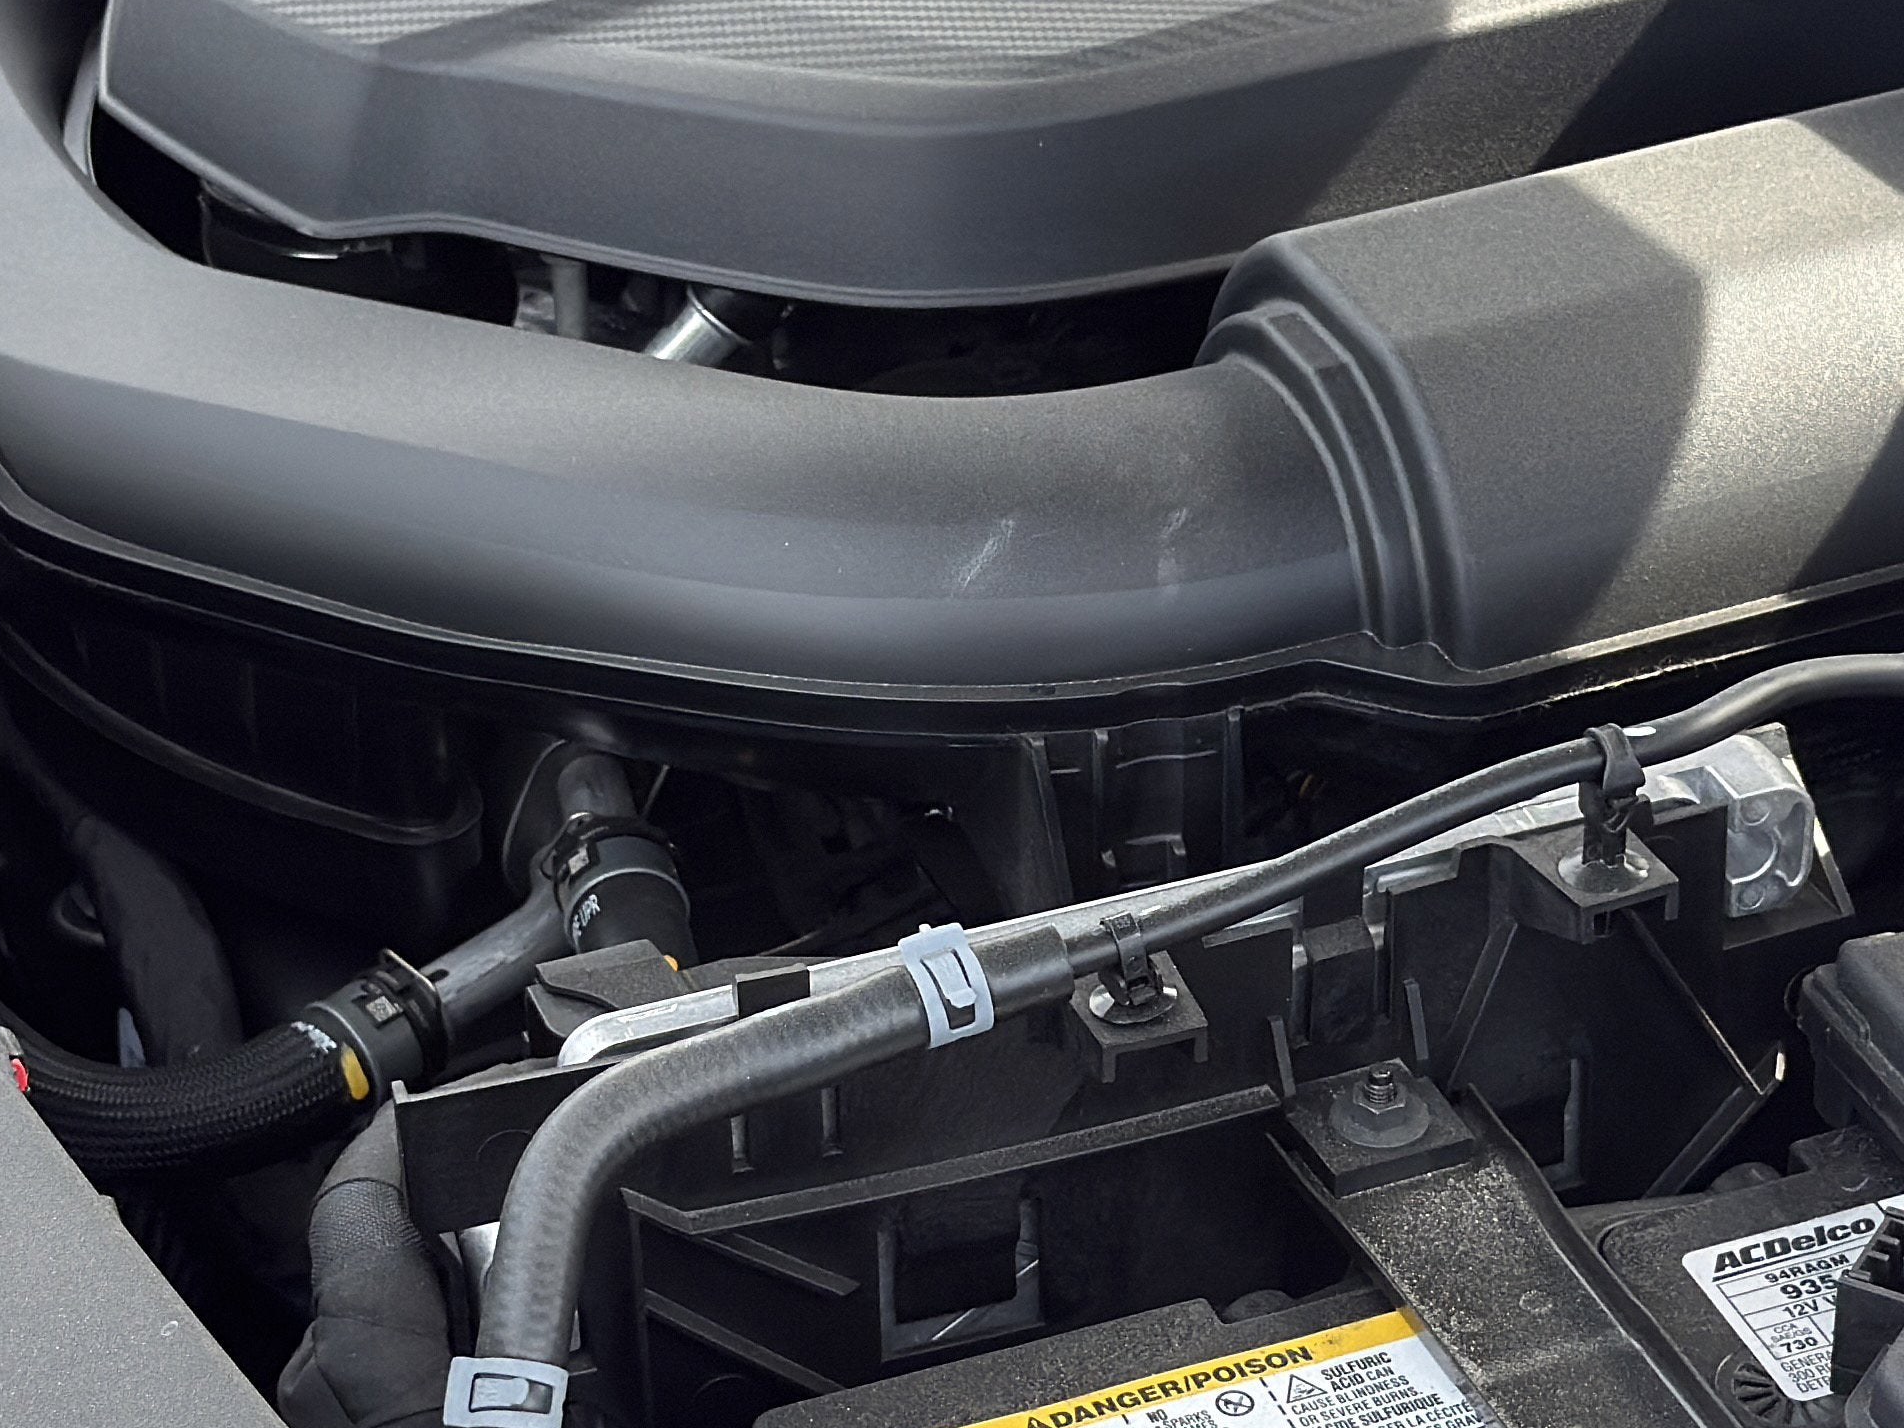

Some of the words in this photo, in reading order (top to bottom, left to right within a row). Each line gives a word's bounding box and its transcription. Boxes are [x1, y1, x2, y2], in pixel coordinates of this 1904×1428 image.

[1714, 1216, 1877, 1275] ACDelco
[1761, 1252, 1851, 1285] 94RAGM
[1780, 1298, 1823, 1319] 12V
[1771, 1321, 1798, 1335] CCA
[1779, 1335, 1819, 1354] 730
[1318, 1351, 1394, 1380] SULFURIC
[1327, 1372, 1367, 1392] ACID
[1363, 1364, 1396, 1381] CAN
[1787, 1368, 1816, 1384] 300
[1046, 1343, 1314, 1428] DANGER/POISON
[1289, 1394, 1337, 1416] CAUSE
[1333, 1374, 1411, 1404] BLINDNESS
[1145, 1408, 1170, 1424] NO
[1297, 1412, 1321, 1428] OR
[1318, 1398, 1375, 1422] SEVERE
[1370, 1384, 1424, 1407] BURNS.
[1355, 1392, 1445, 1427] SULFURIQUE
[1404, 1414, 1427, 1428] LA
